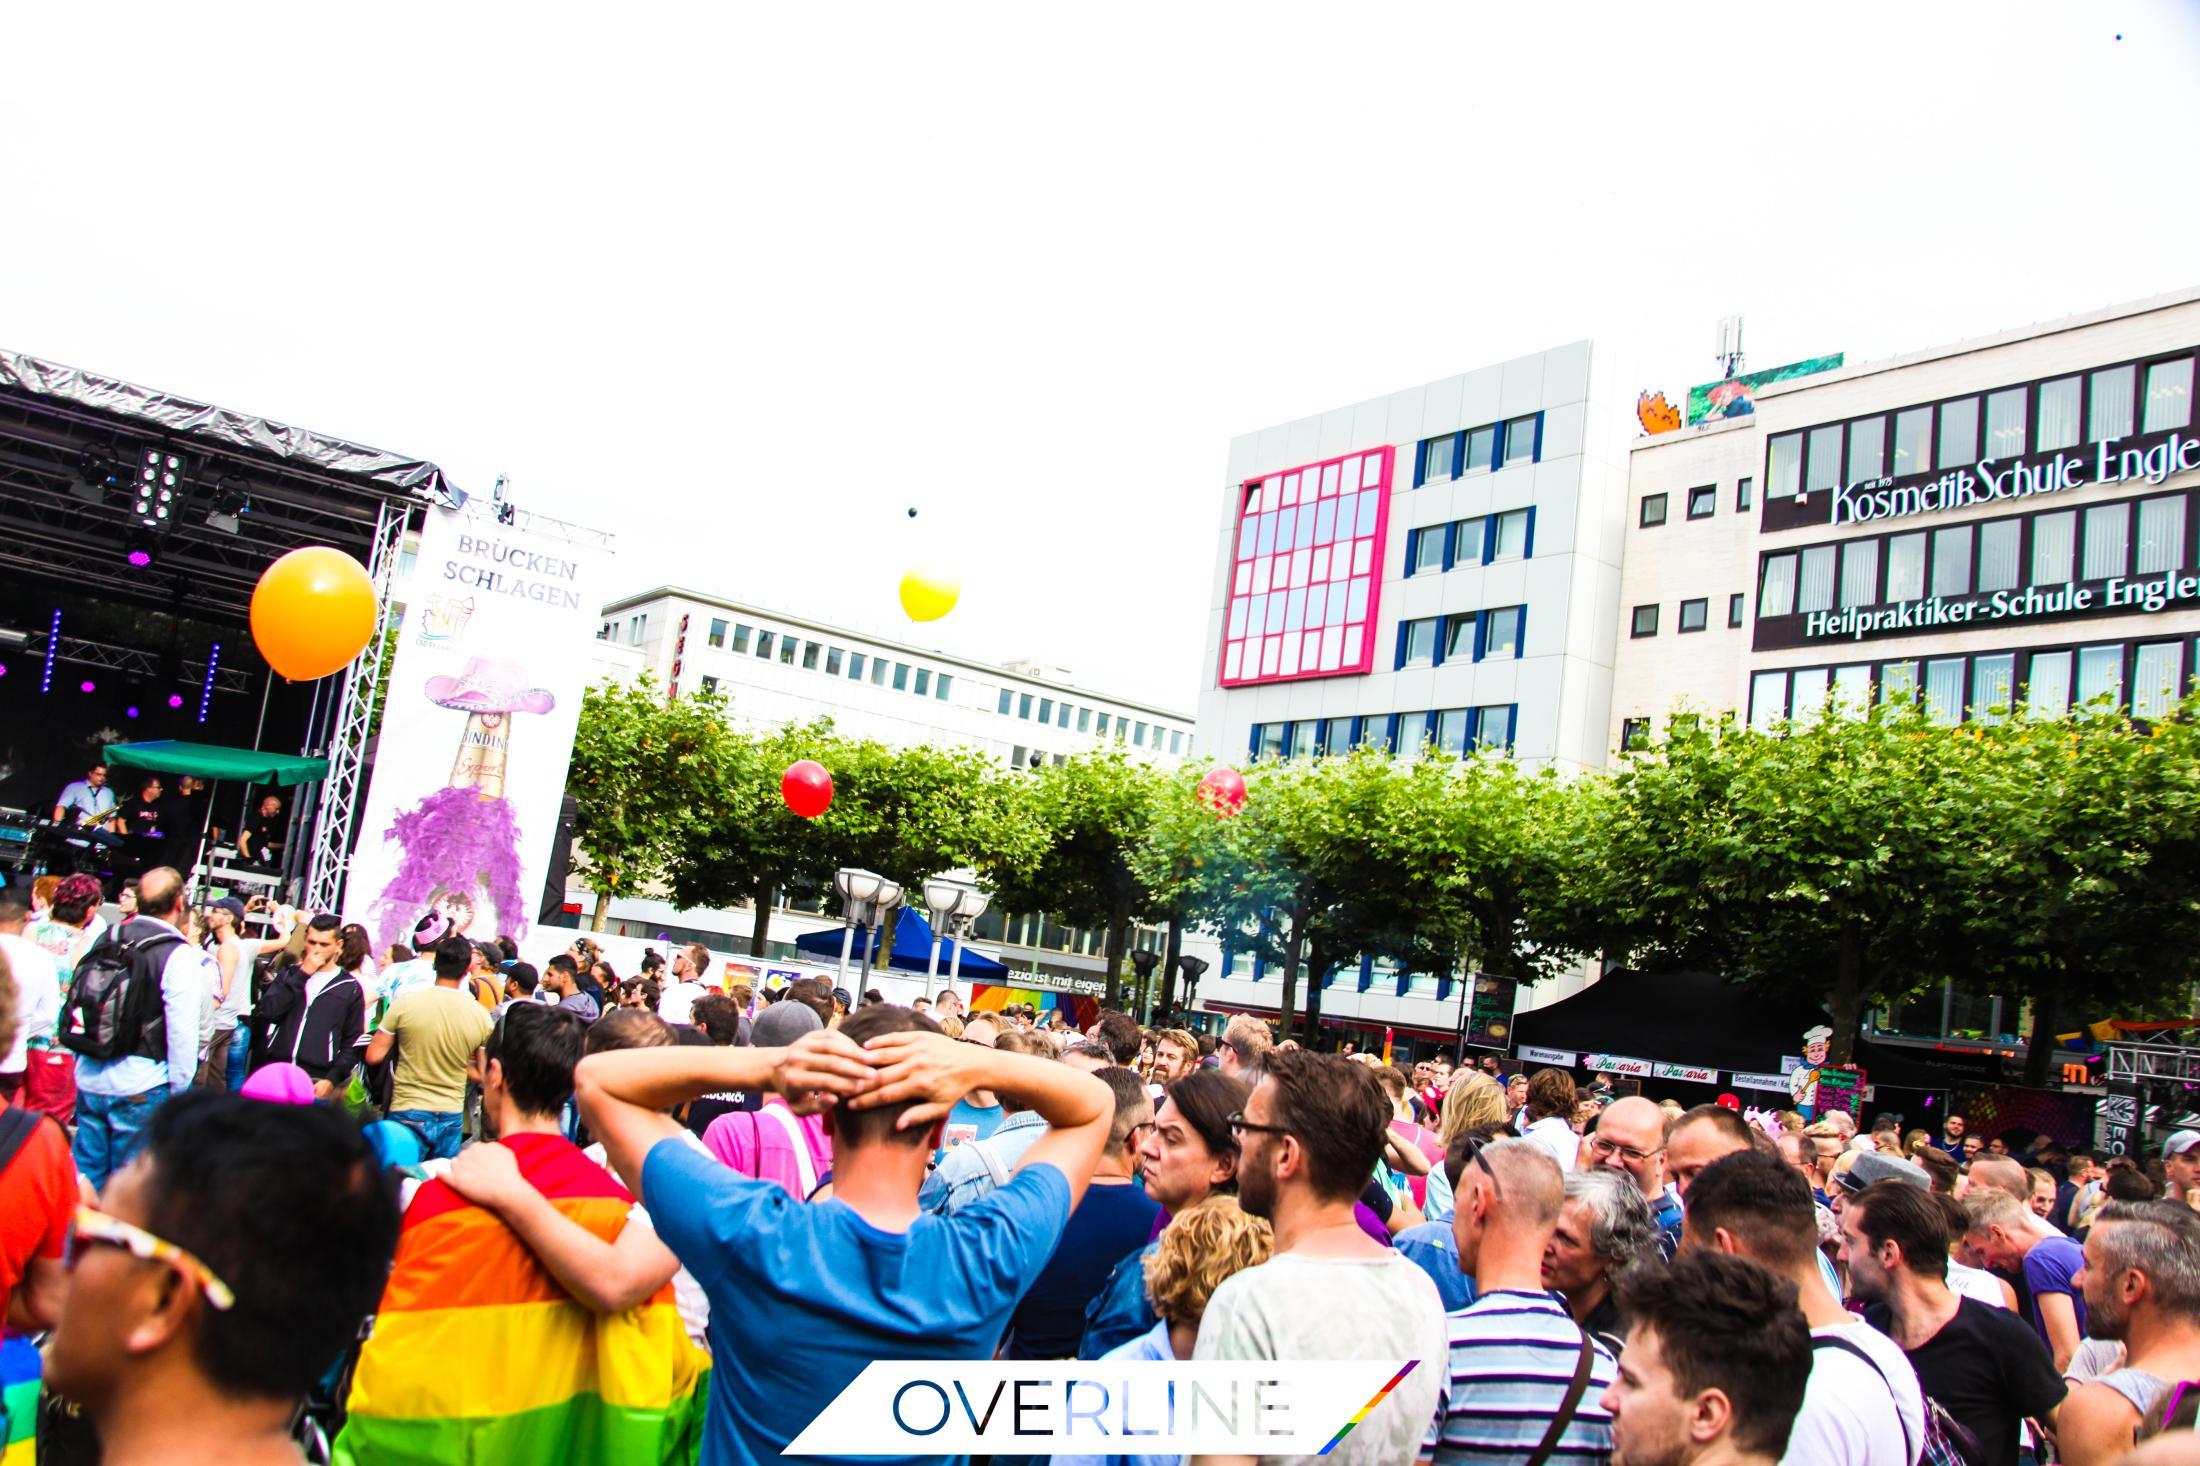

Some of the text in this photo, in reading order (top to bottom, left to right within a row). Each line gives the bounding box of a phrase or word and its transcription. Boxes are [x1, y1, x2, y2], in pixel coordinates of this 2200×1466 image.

[457, 534, 578, 580] BRÜCKEN
[444, 561, 580, 610] SCHLAGEN
[1806, 570, 2200, 640] Heilpraktiker-Schule Engle
[1052, 973, 1073, 988] mit
